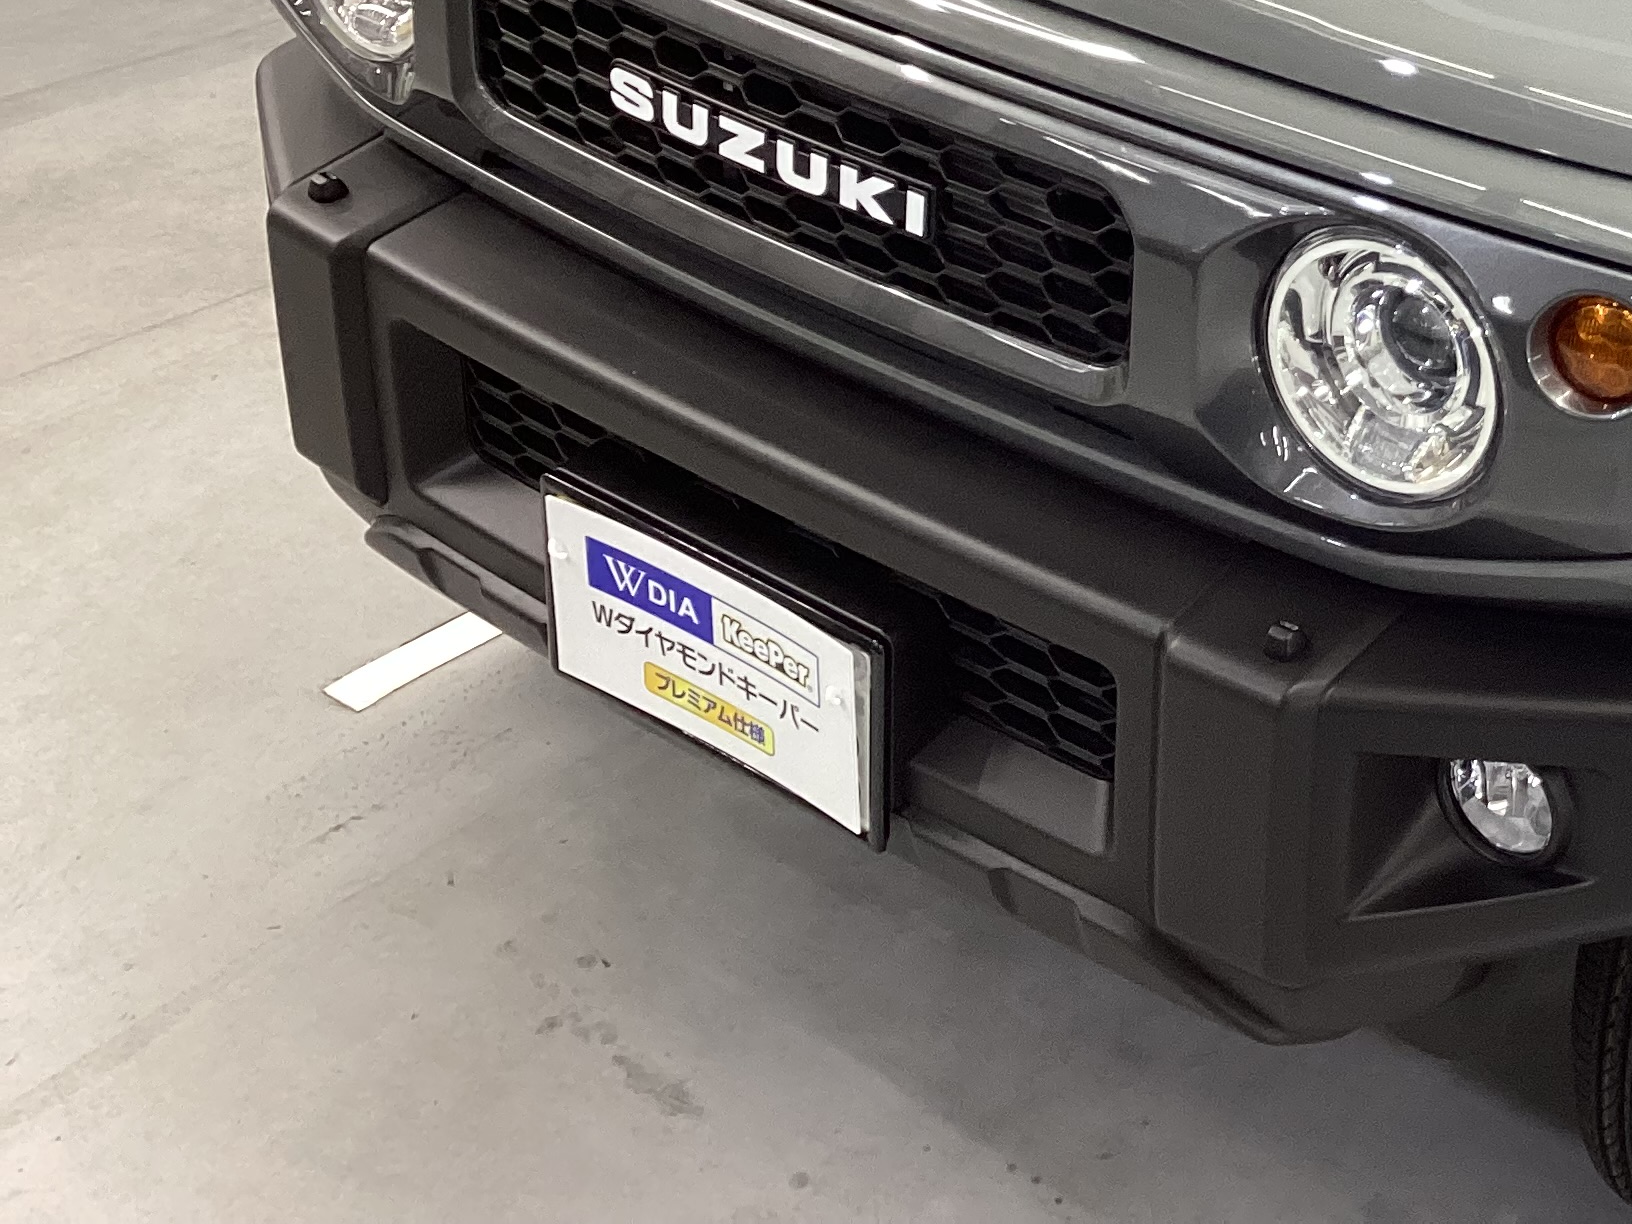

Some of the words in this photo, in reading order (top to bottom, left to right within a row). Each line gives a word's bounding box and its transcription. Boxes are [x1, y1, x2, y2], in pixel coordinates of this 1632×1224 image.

[609, 67, 926, 238] SUZUKI
[591, 600, 820, 733] Wダイヤモンドキーパー
[720, 613, 811, 689] KeePer
[655, 672, 767, 746] プレミアム仕様
